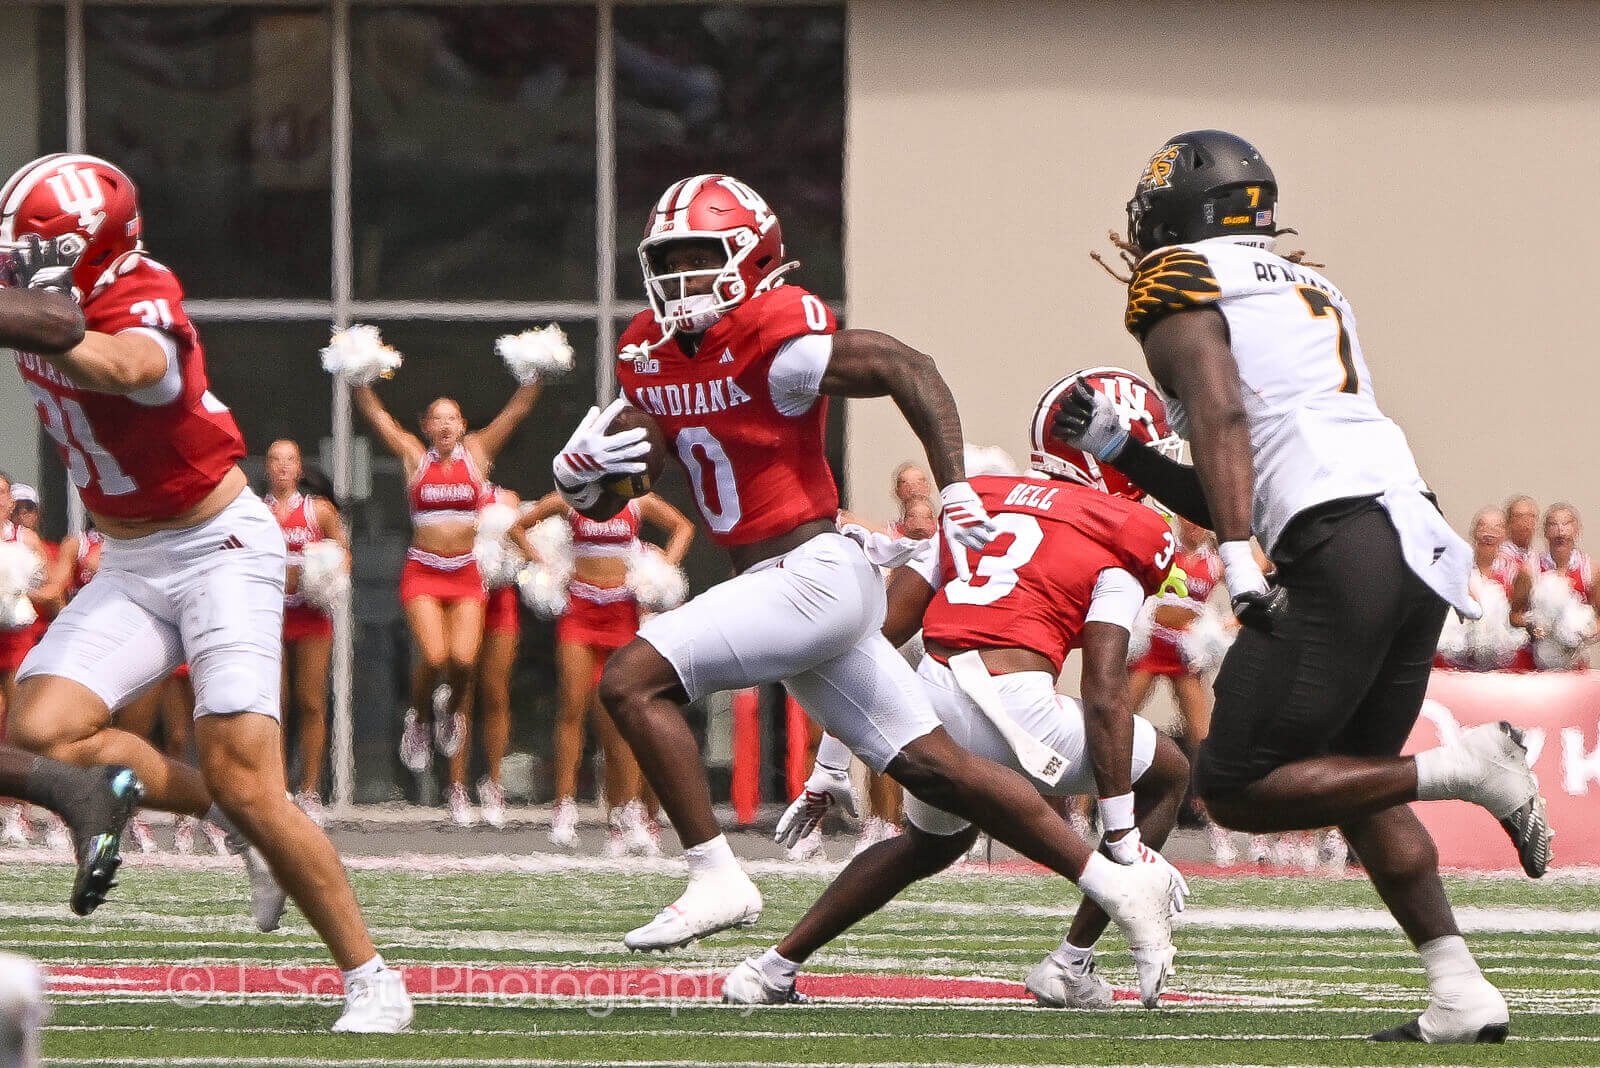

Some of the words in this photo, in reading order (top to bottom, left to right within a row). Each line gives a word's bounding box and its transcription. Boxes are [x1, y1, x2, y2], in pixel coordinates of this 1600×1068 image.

[1245, 186, 1261, 208] 7
[129, 299, 174, 330] 31
[801, 294, 827, 332] 0
[1295, 284, 1360, 394] 7
[635, 376, 752, 416] INDIANA
[26, 381, 138, 495] 31
[676, 426, 742, 533] 0
[1004, 483, 1059, 510] BELL
[945, 512, 1044, 606] 3
[1153, 531, 1175, 570] 3
